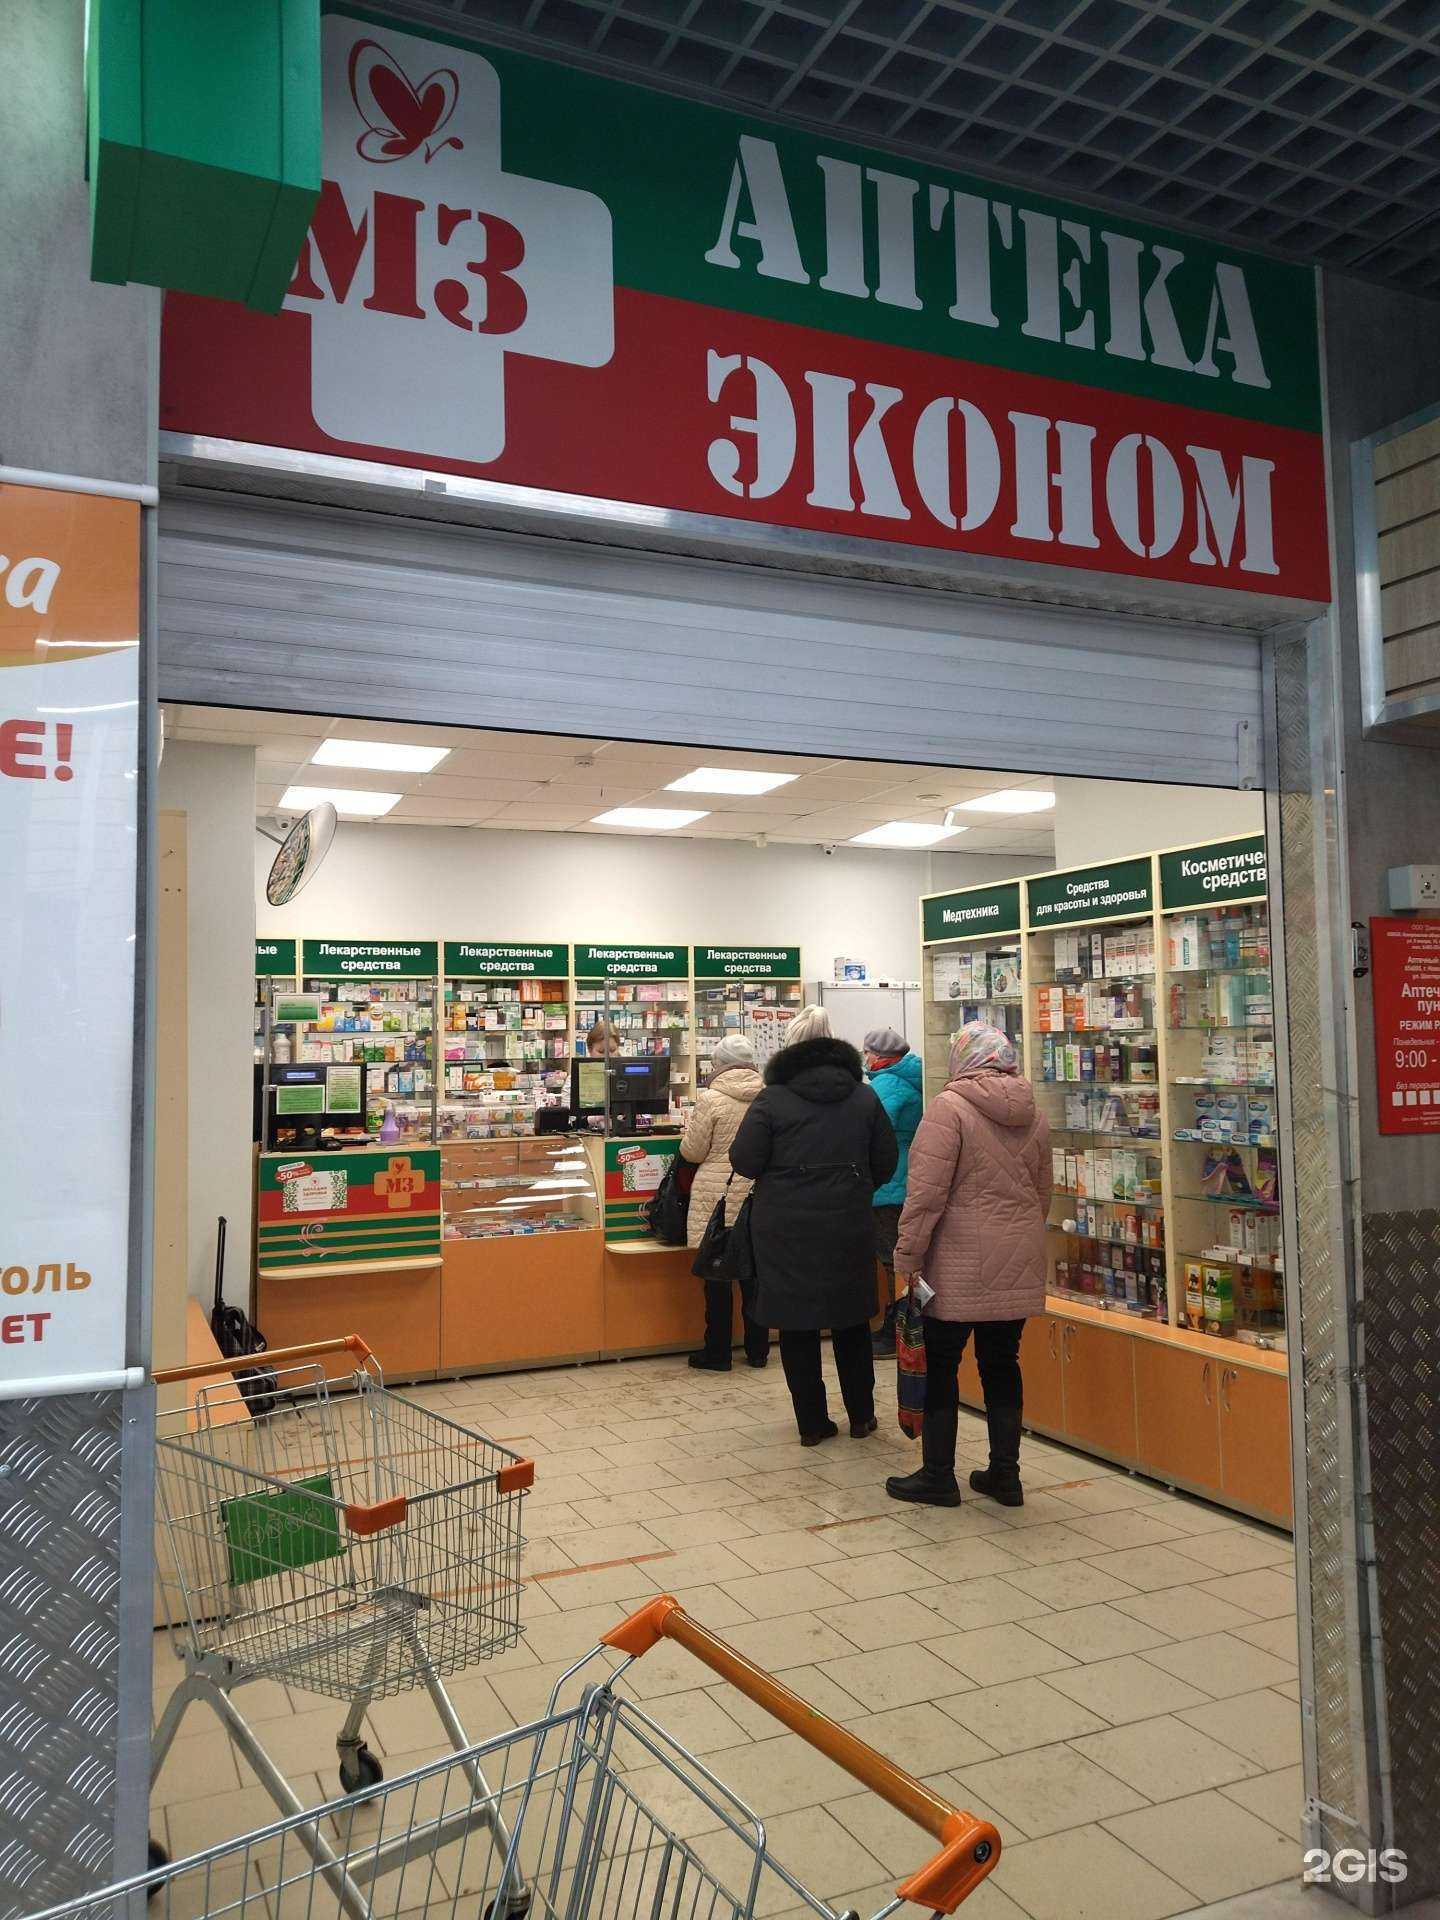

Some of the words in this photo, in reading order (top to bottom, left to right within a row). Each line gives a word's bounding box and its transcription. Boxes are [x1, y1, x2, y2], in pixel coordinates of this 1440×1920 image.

[704, 133, 1271, 389] АПТЕКА
[706, 348, 1281, 576] ЭКОНОМ
[0, 553, 61, 614] а
[1181, 851, 1266, 877] Косметиче
[1066, 879, 1110, 896] Средства
[1036, 904, 1053, 916] для
[1053, 898, 1090, 913] красоты
[1091, 897, 1099, 906] и
[1100, 889, 1147, 905] здоровья
[943, 904, 1000, 923] Медтехника
[319, 943, 422, 957] Лекарственные
[459, 945, 554, 958] Лекарственные
[588, 948, 675, 960] Лекарственные
[706, 949, 787, 961] Лекарственные
[340, 960, 401, 972] средства
[479, 961, 535, 972] средства
[606, 963, 658, 974] средства
[724, 964, 772, 974] средства
[1399, 1020, 1433, 1031] РЕЖИМ
[1395, 1050, 1427, 1068] 9:00
